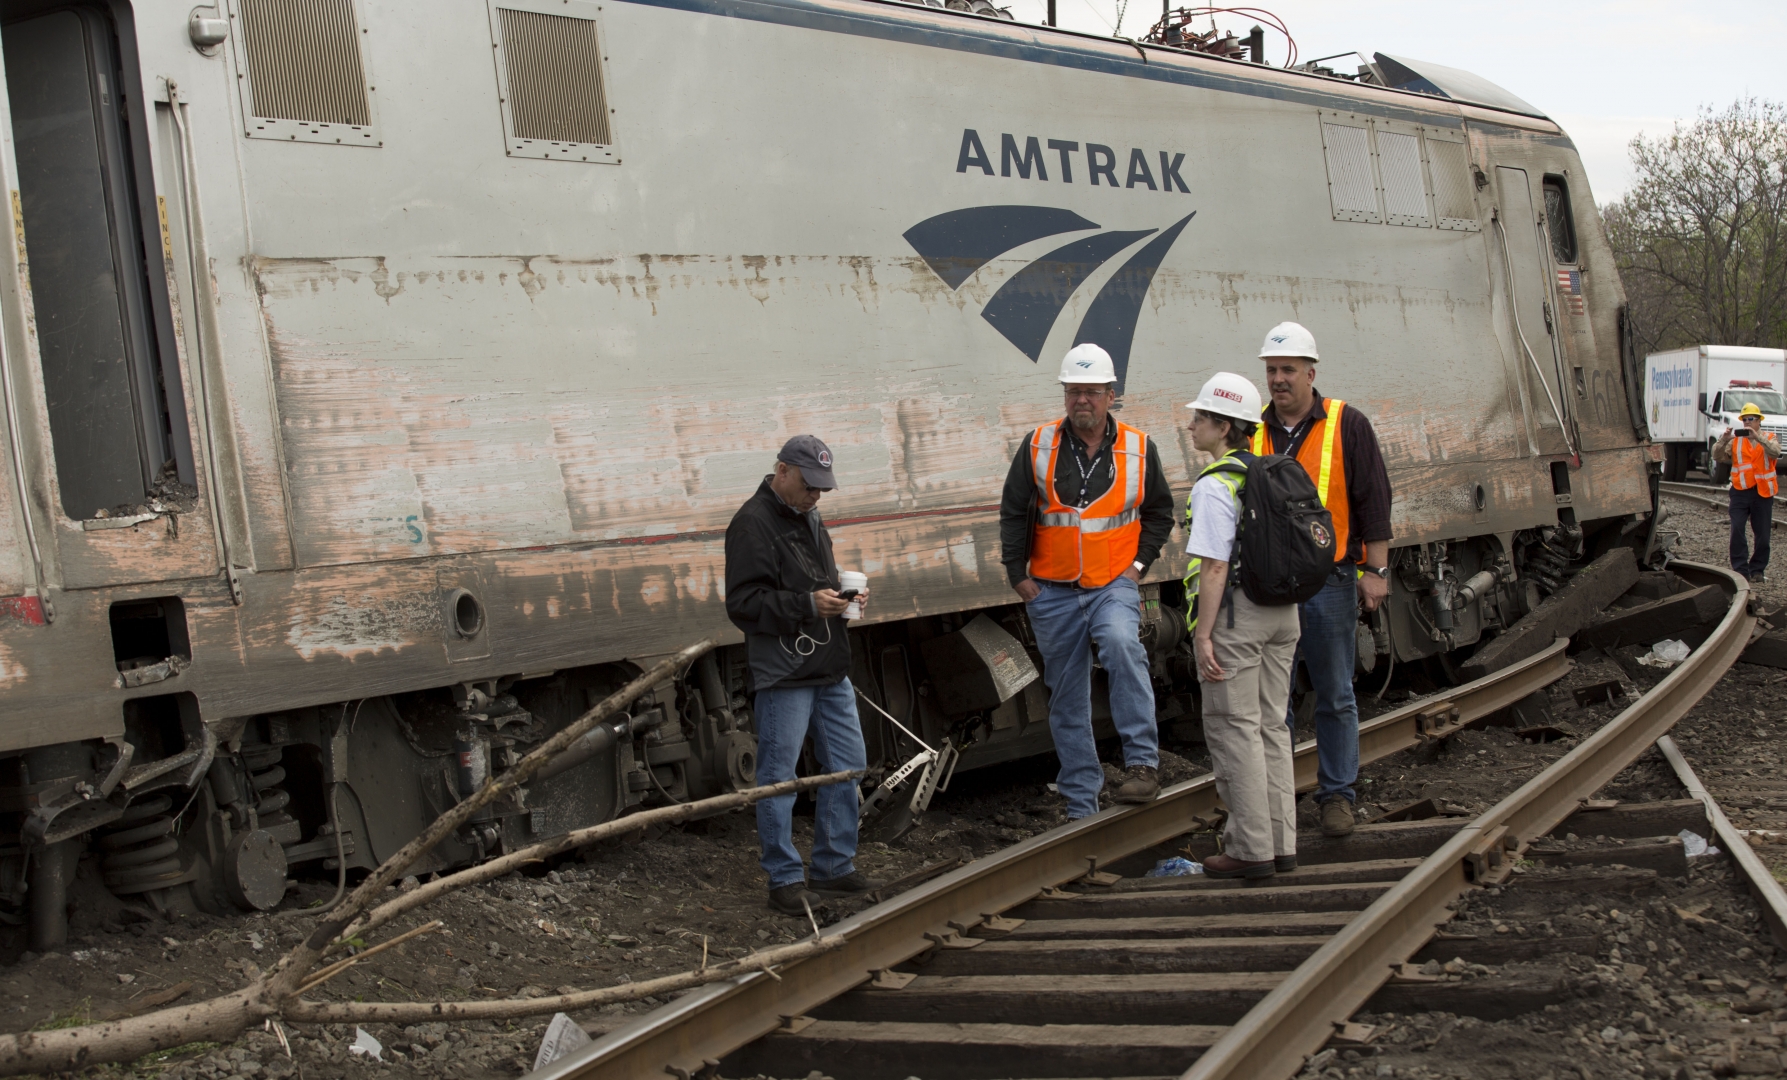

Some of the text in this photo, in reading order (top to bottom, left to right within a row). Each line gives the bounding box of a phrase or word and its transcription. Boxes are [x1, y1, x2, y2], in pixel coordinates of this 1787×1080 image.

[956, 128, 1191, 194] AMTRAK
[160, 197, 171, 258] PINCH
[1214, 388, 1242, 403] NTSB
[1652, 362, 1692, 394] Pennsylvania
